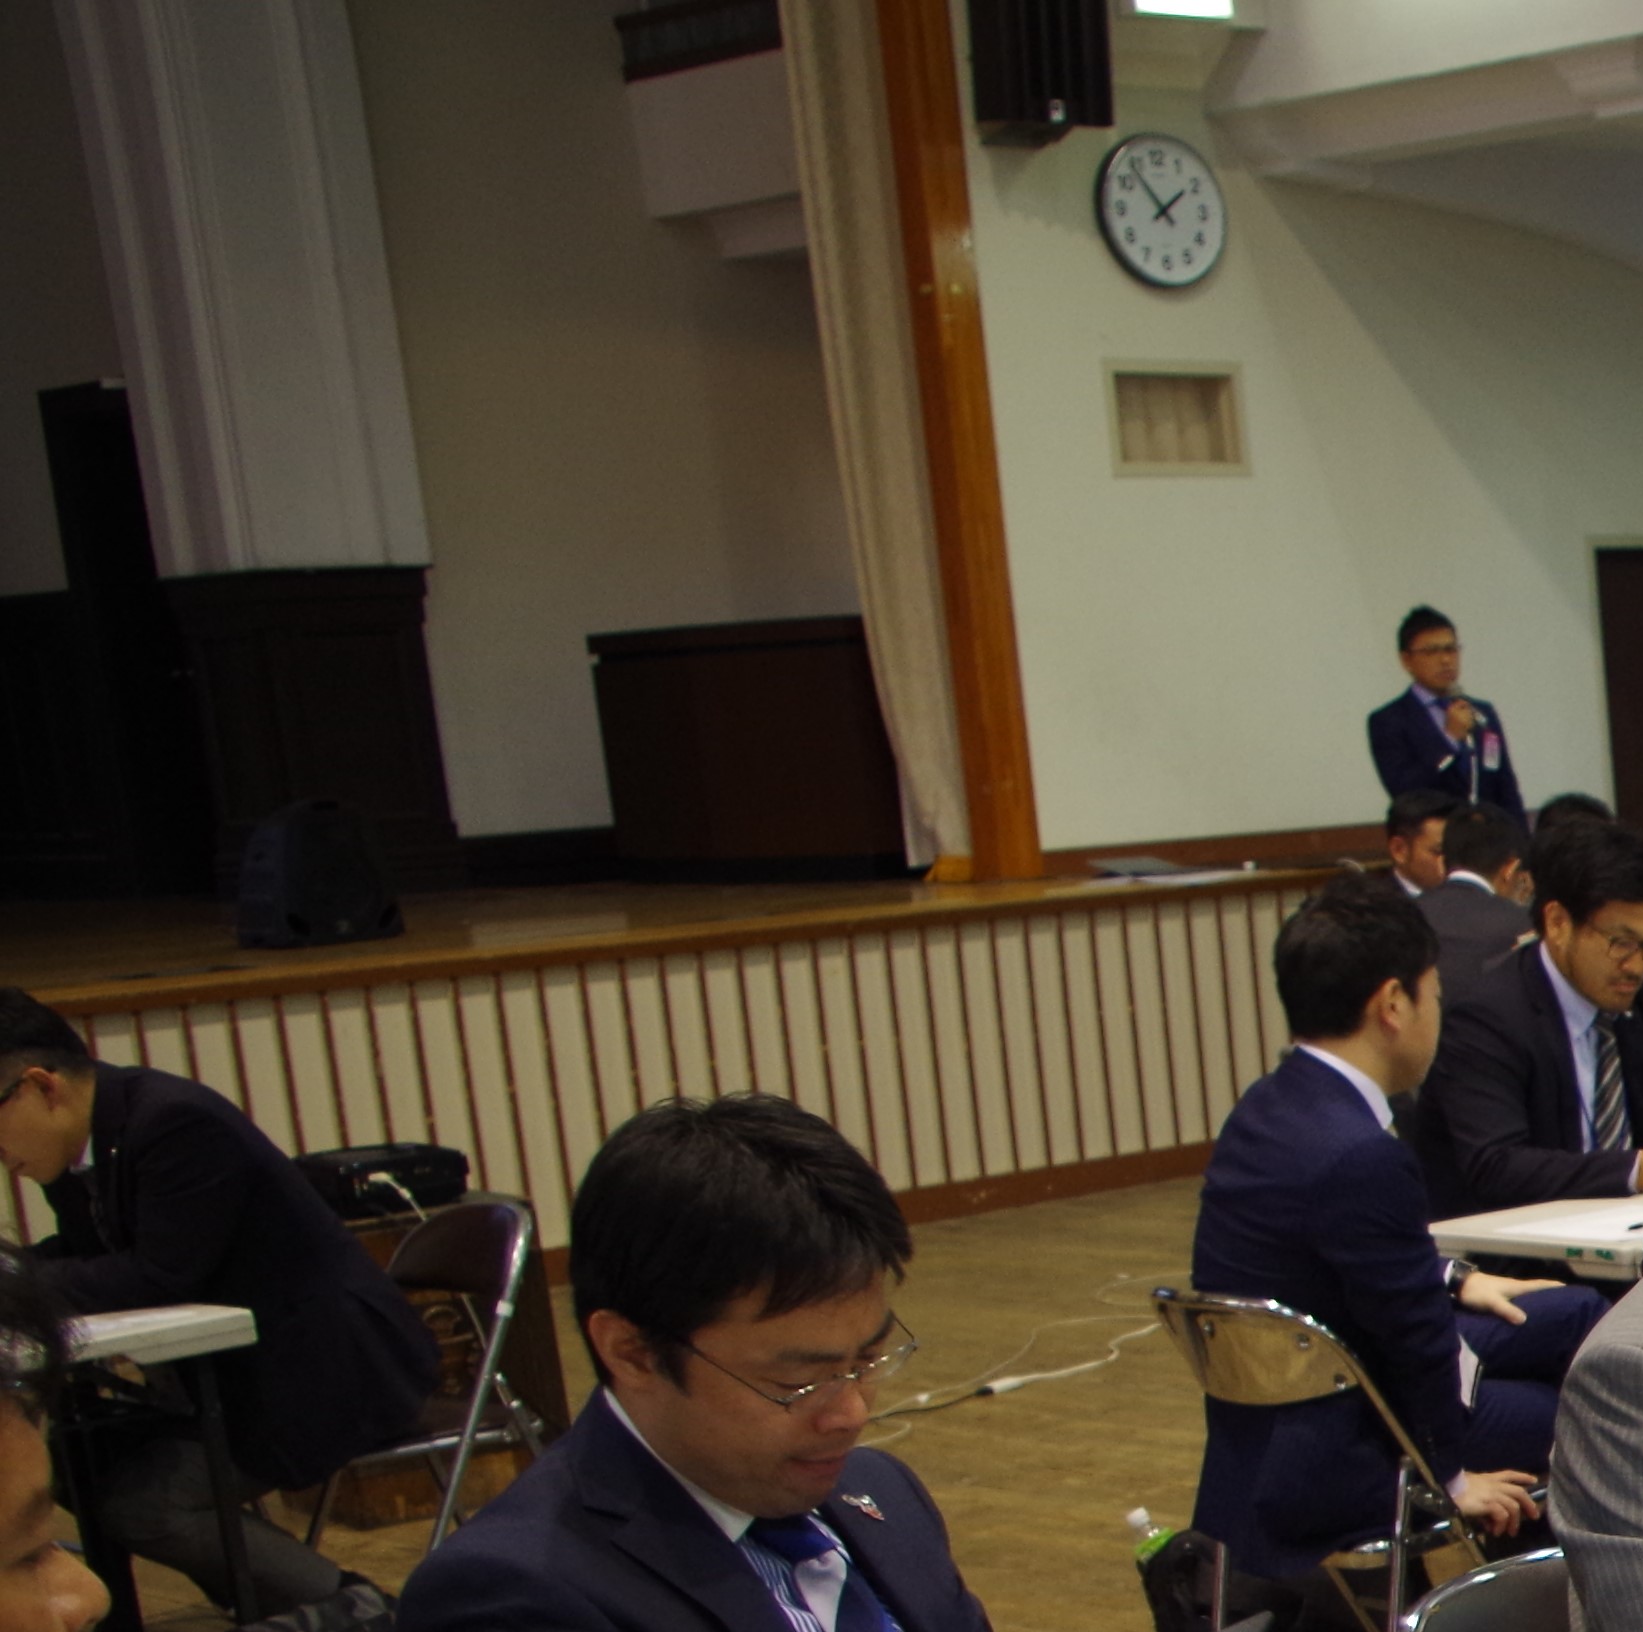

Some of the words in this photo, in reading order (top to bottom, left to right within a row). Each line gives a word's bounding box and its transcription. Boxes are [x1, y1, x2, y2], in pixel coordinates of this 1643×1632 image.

[1148, 149, 1164, 167] 12
[1174, 158, 1182, 175] 1
[1189, 177, 1199, 194] 2
[1198, 204, 1207, 221] 3
[1194, 230, 1206, 245] 4
[1142, 245, 1152, 262] 7
[1182, 248, 1193, 265] 5
